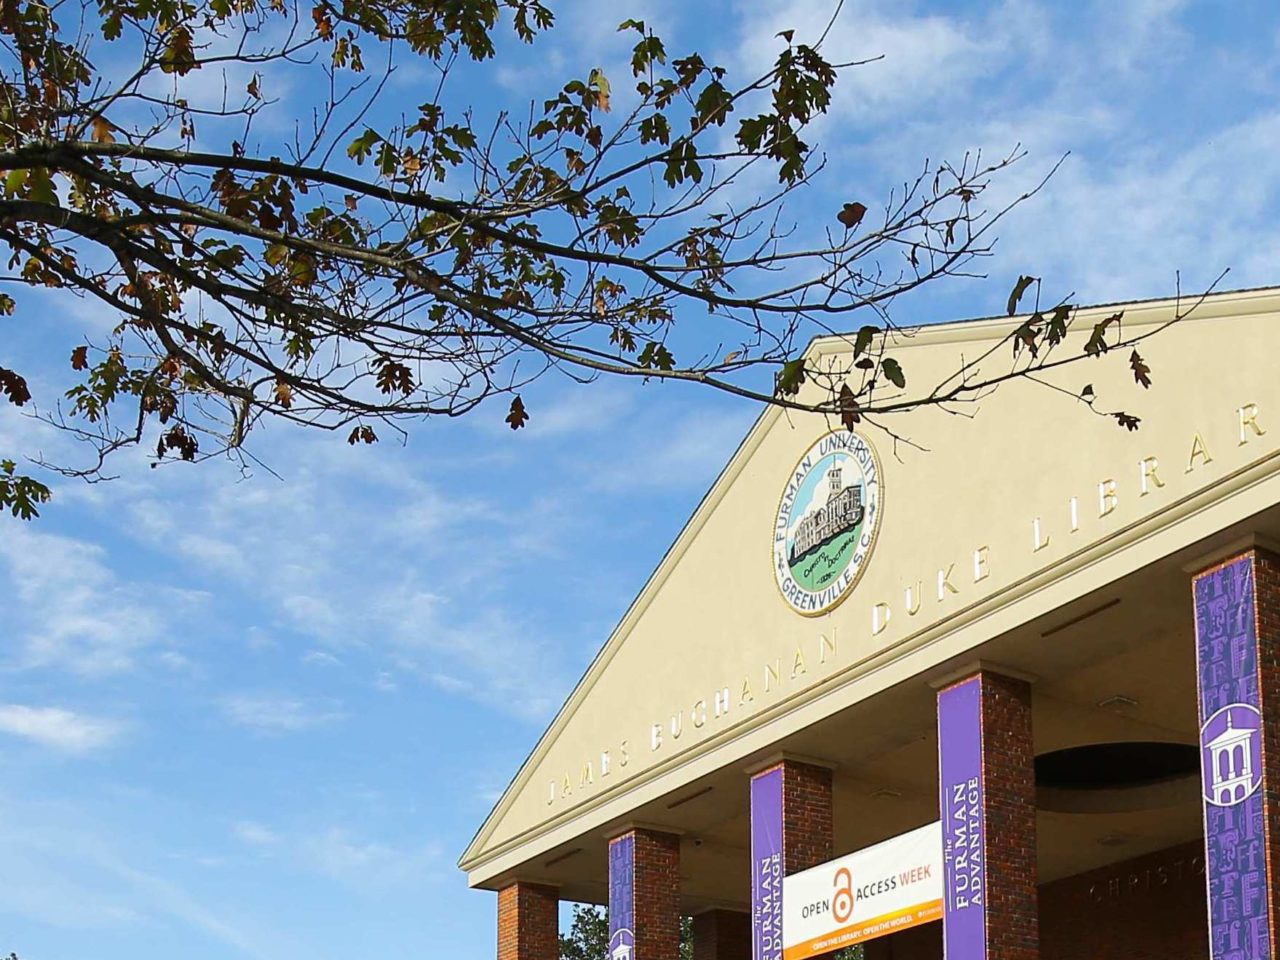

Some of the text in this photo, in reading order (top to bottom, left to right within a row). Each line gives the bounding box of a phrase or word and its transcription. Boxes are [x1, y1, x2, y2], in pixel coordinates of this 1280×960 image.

[776, 433, 878, 542] FURMAN UNIVERSITY
[547, 740, 629, 806] JAMES
[651, 627, 839, 752] BUCHANAN
[872, 545, 991, 636] DUKE
[802, 864, 931, 919] OPEN ACCESS WEEK
[945, 839, 953, 863] The
[954, 783, 969, 910] FURMAN
[968, 777, 982, 905] ADVANTAGE
